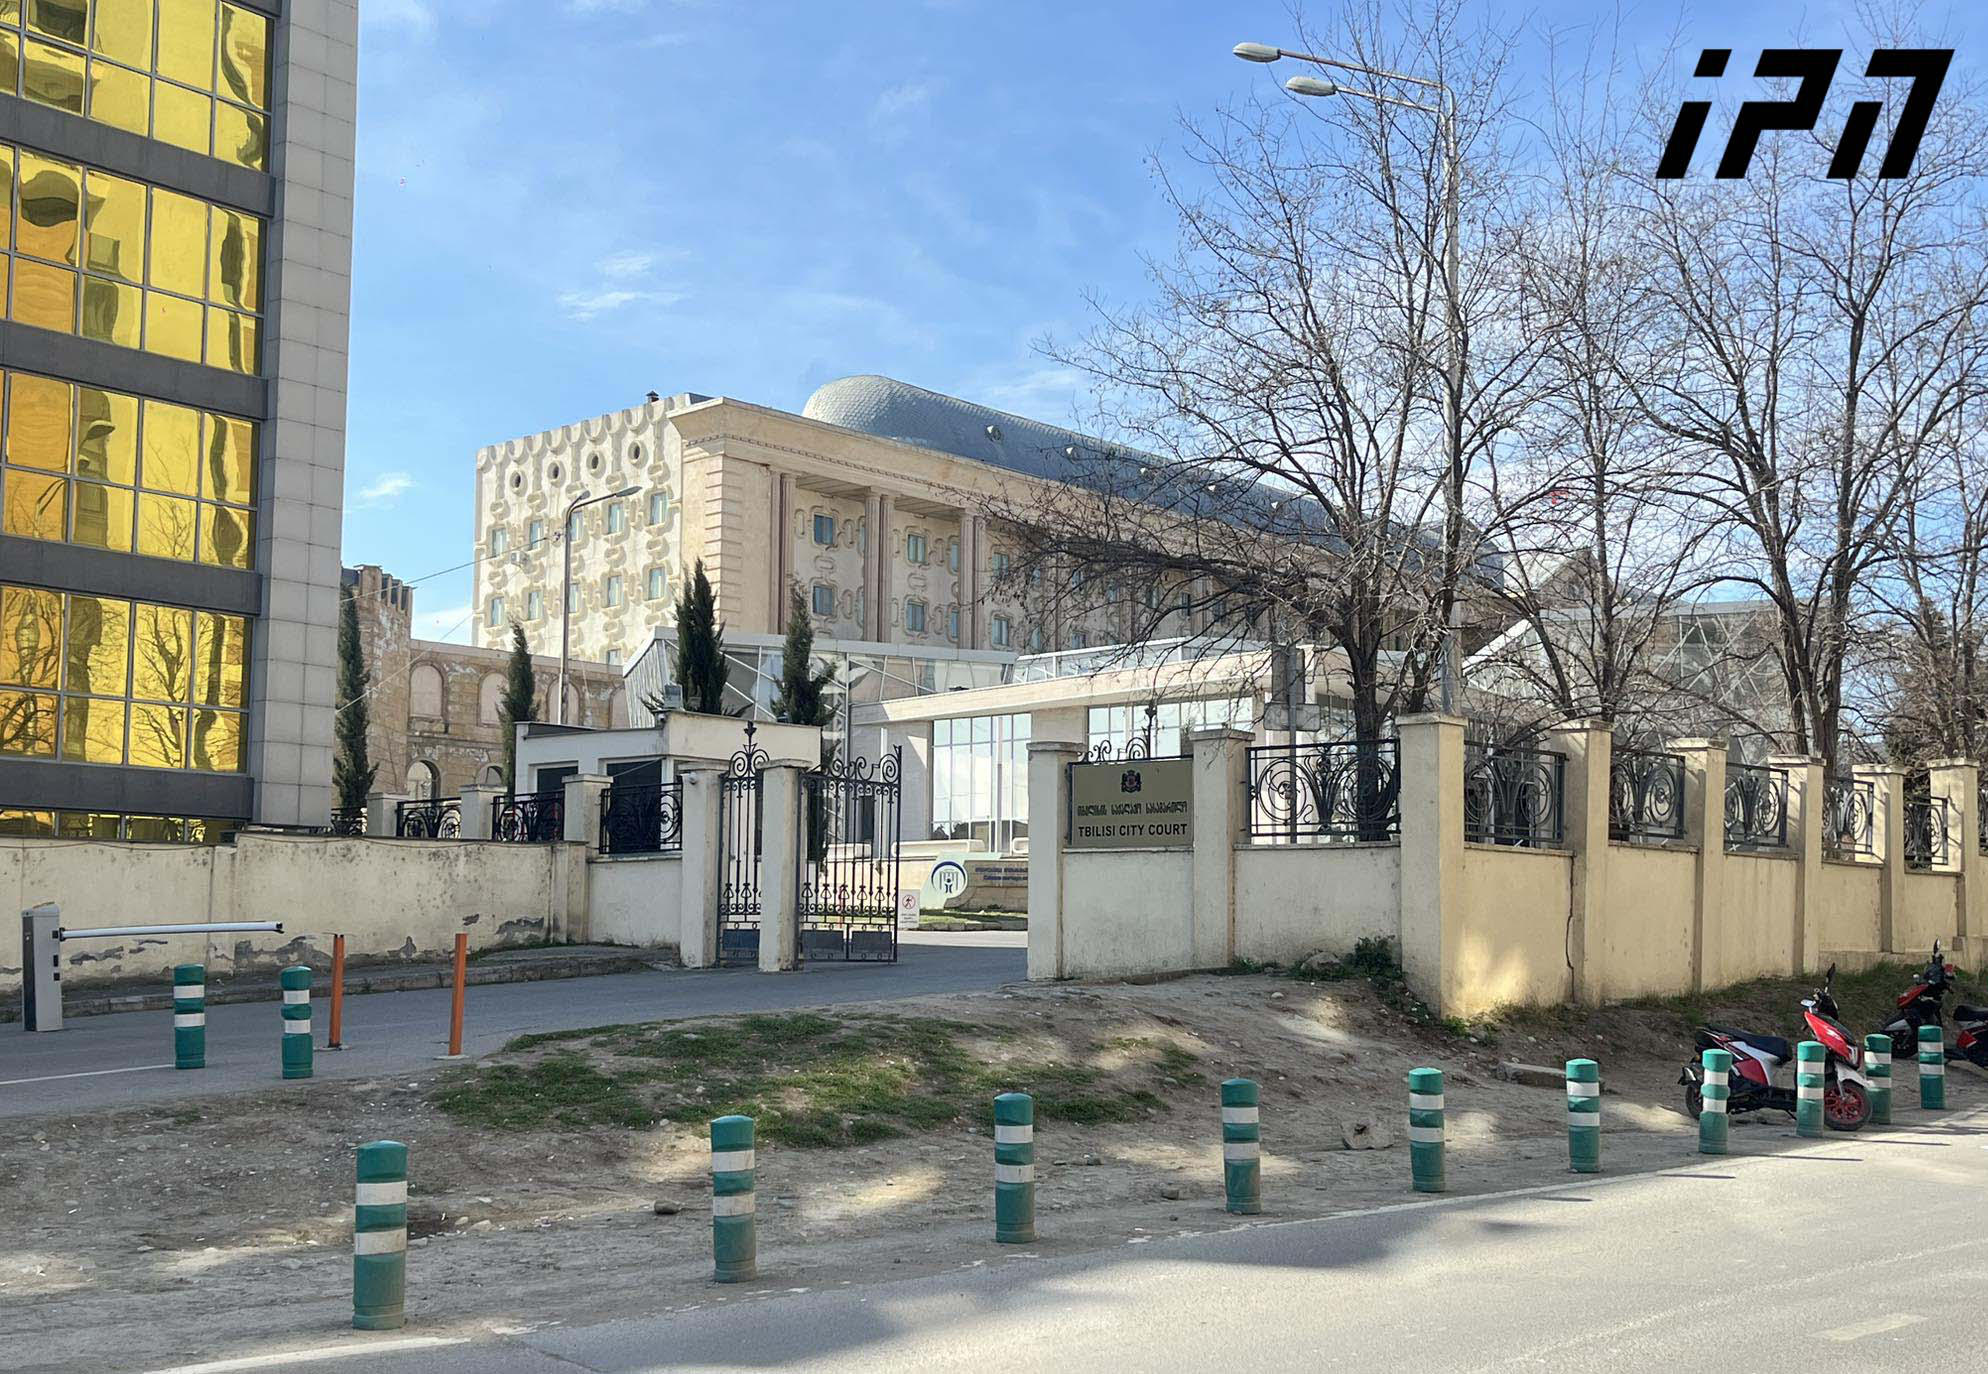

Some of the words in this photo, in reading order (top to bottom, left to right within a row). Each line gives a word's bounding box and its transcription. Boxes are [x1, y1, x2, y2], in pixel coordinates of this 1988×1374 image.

[1078, 825, 1116, 838] TBILISI
[1119, 824, 1145, 837] CITY
[1148, 823, 1188, 836] COURT
